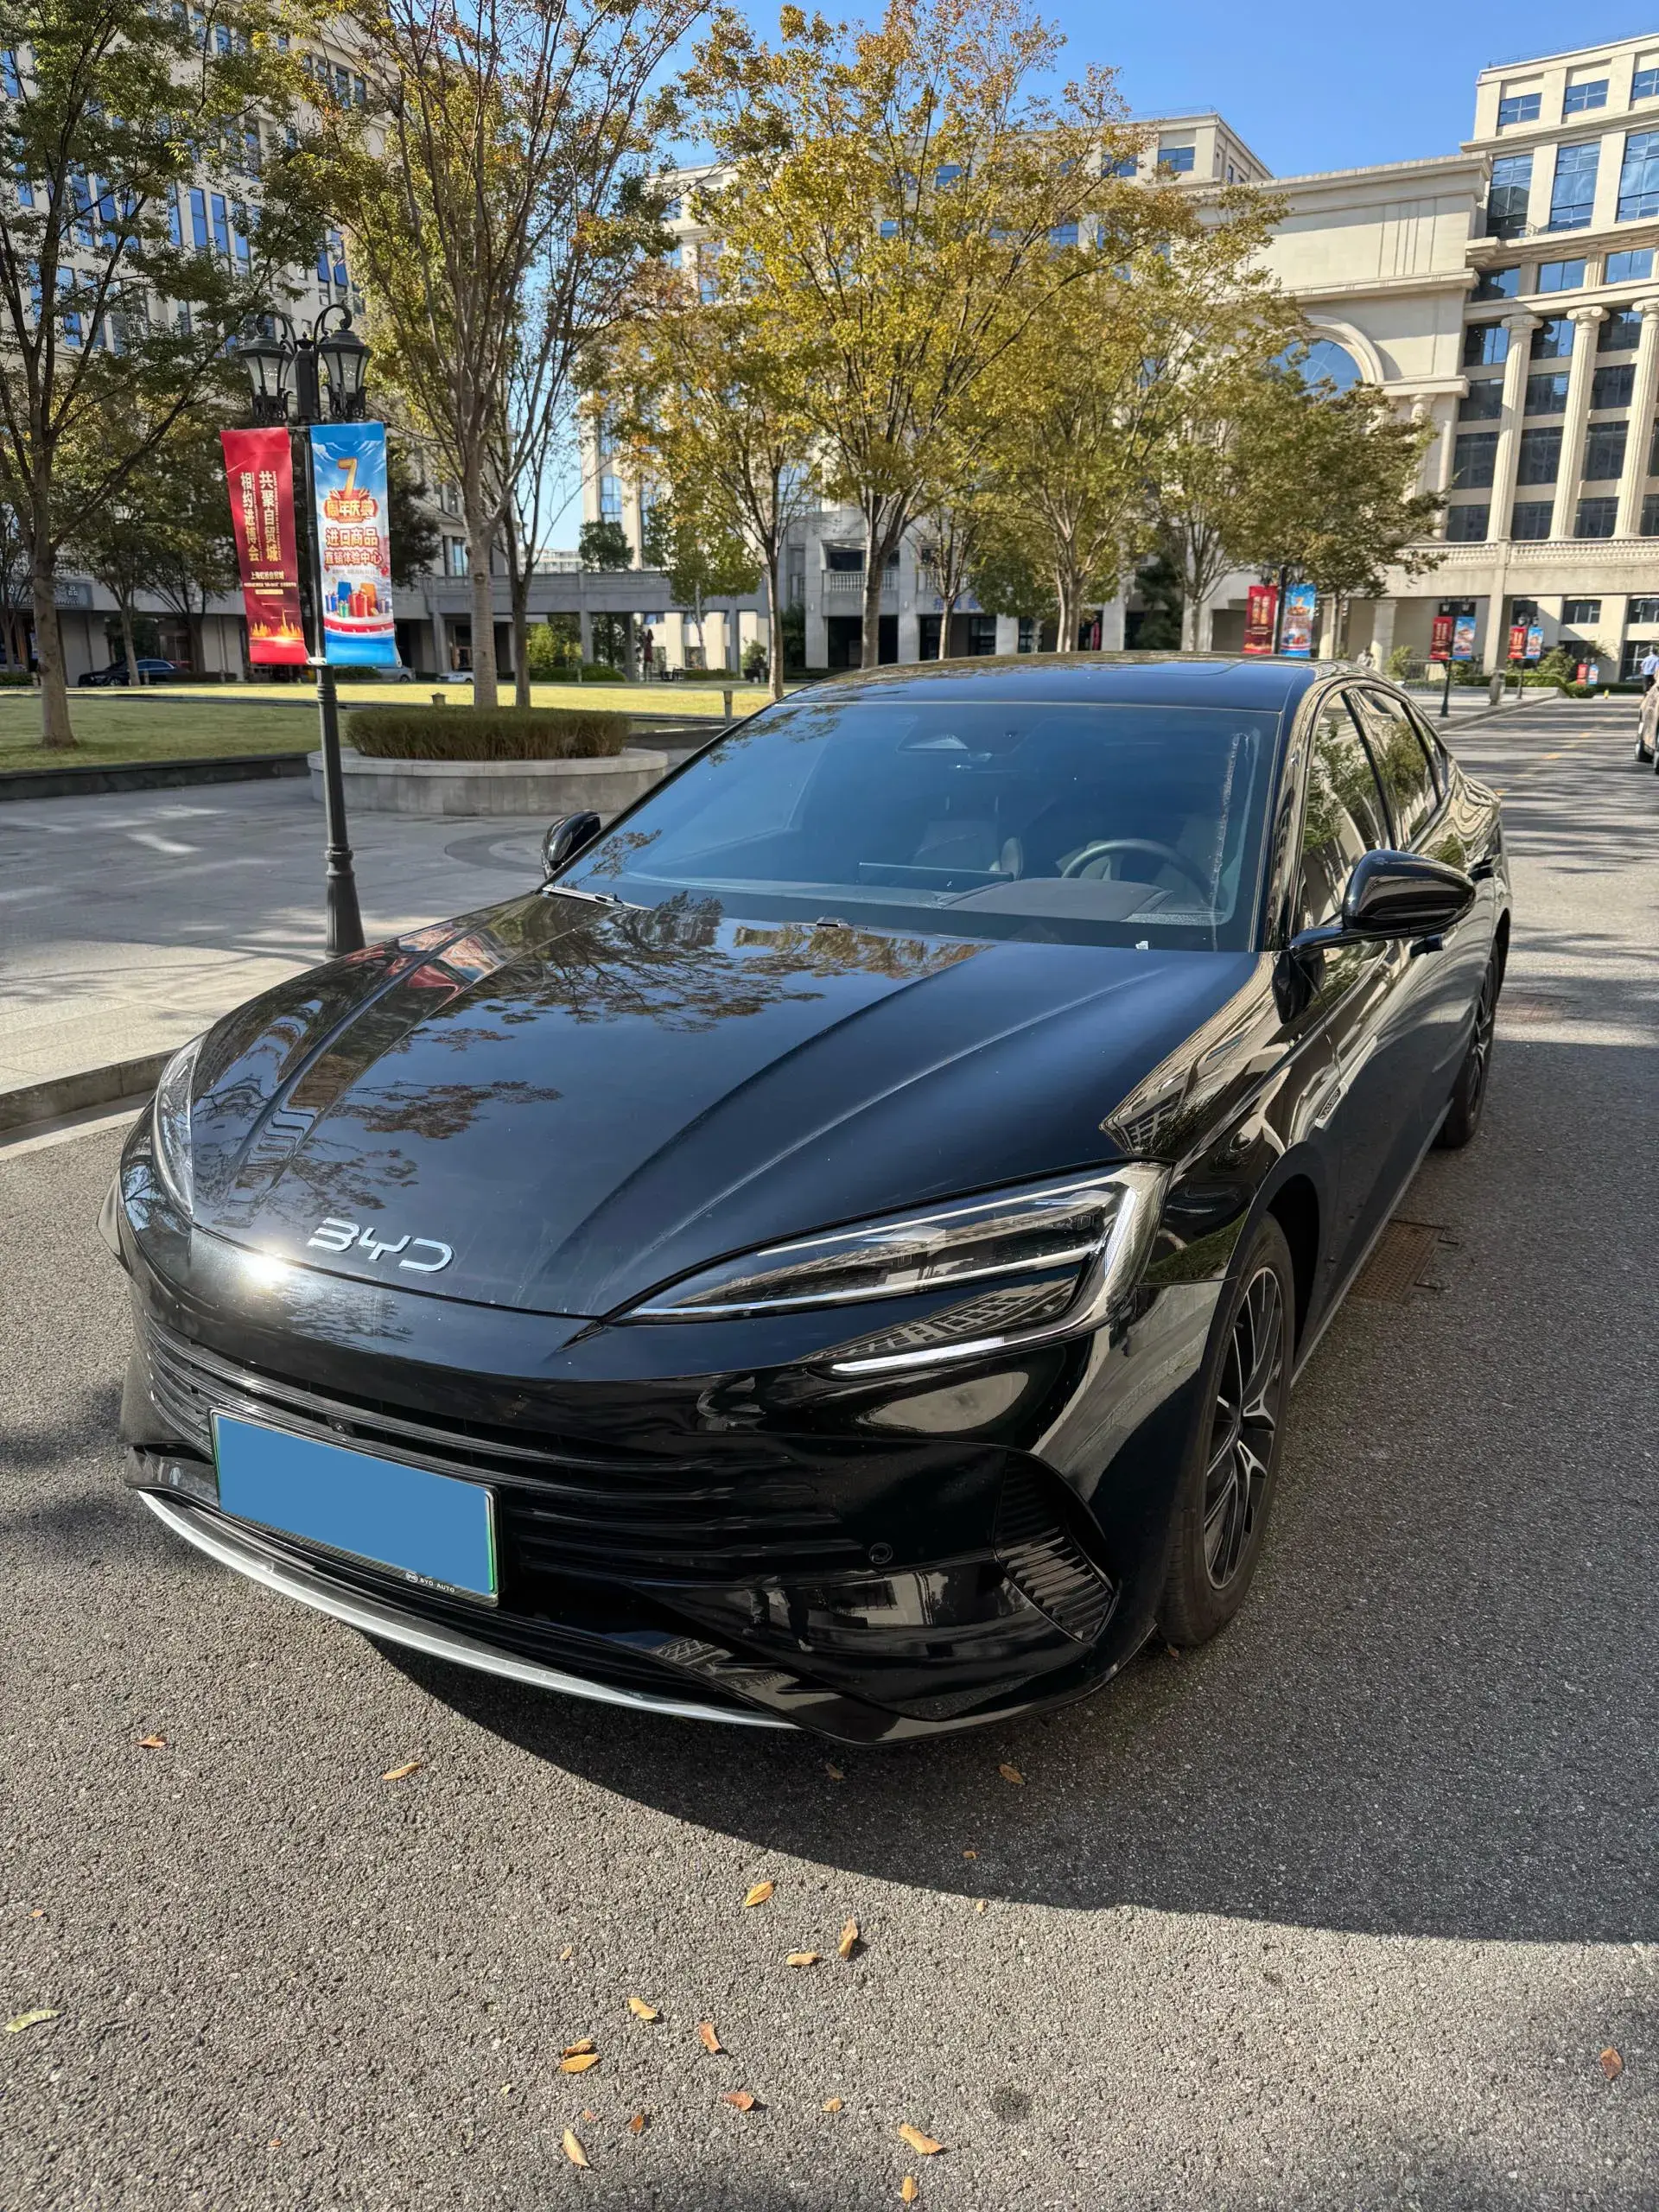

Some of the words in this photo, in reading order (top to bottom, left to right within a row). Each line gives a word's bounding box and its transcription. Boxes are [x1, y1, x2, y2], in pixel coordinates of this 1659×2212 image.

[337, 457, 358, 499] 7
[258, 470, 278, 562] 共聚自贸城
[326, 527, 379, 547] 进口商品
[324, 549, 383, 566] 直销体验中心
[307, 1217, 454, 1273] BYD
[436, 1583, 455, 1592] AUTO
